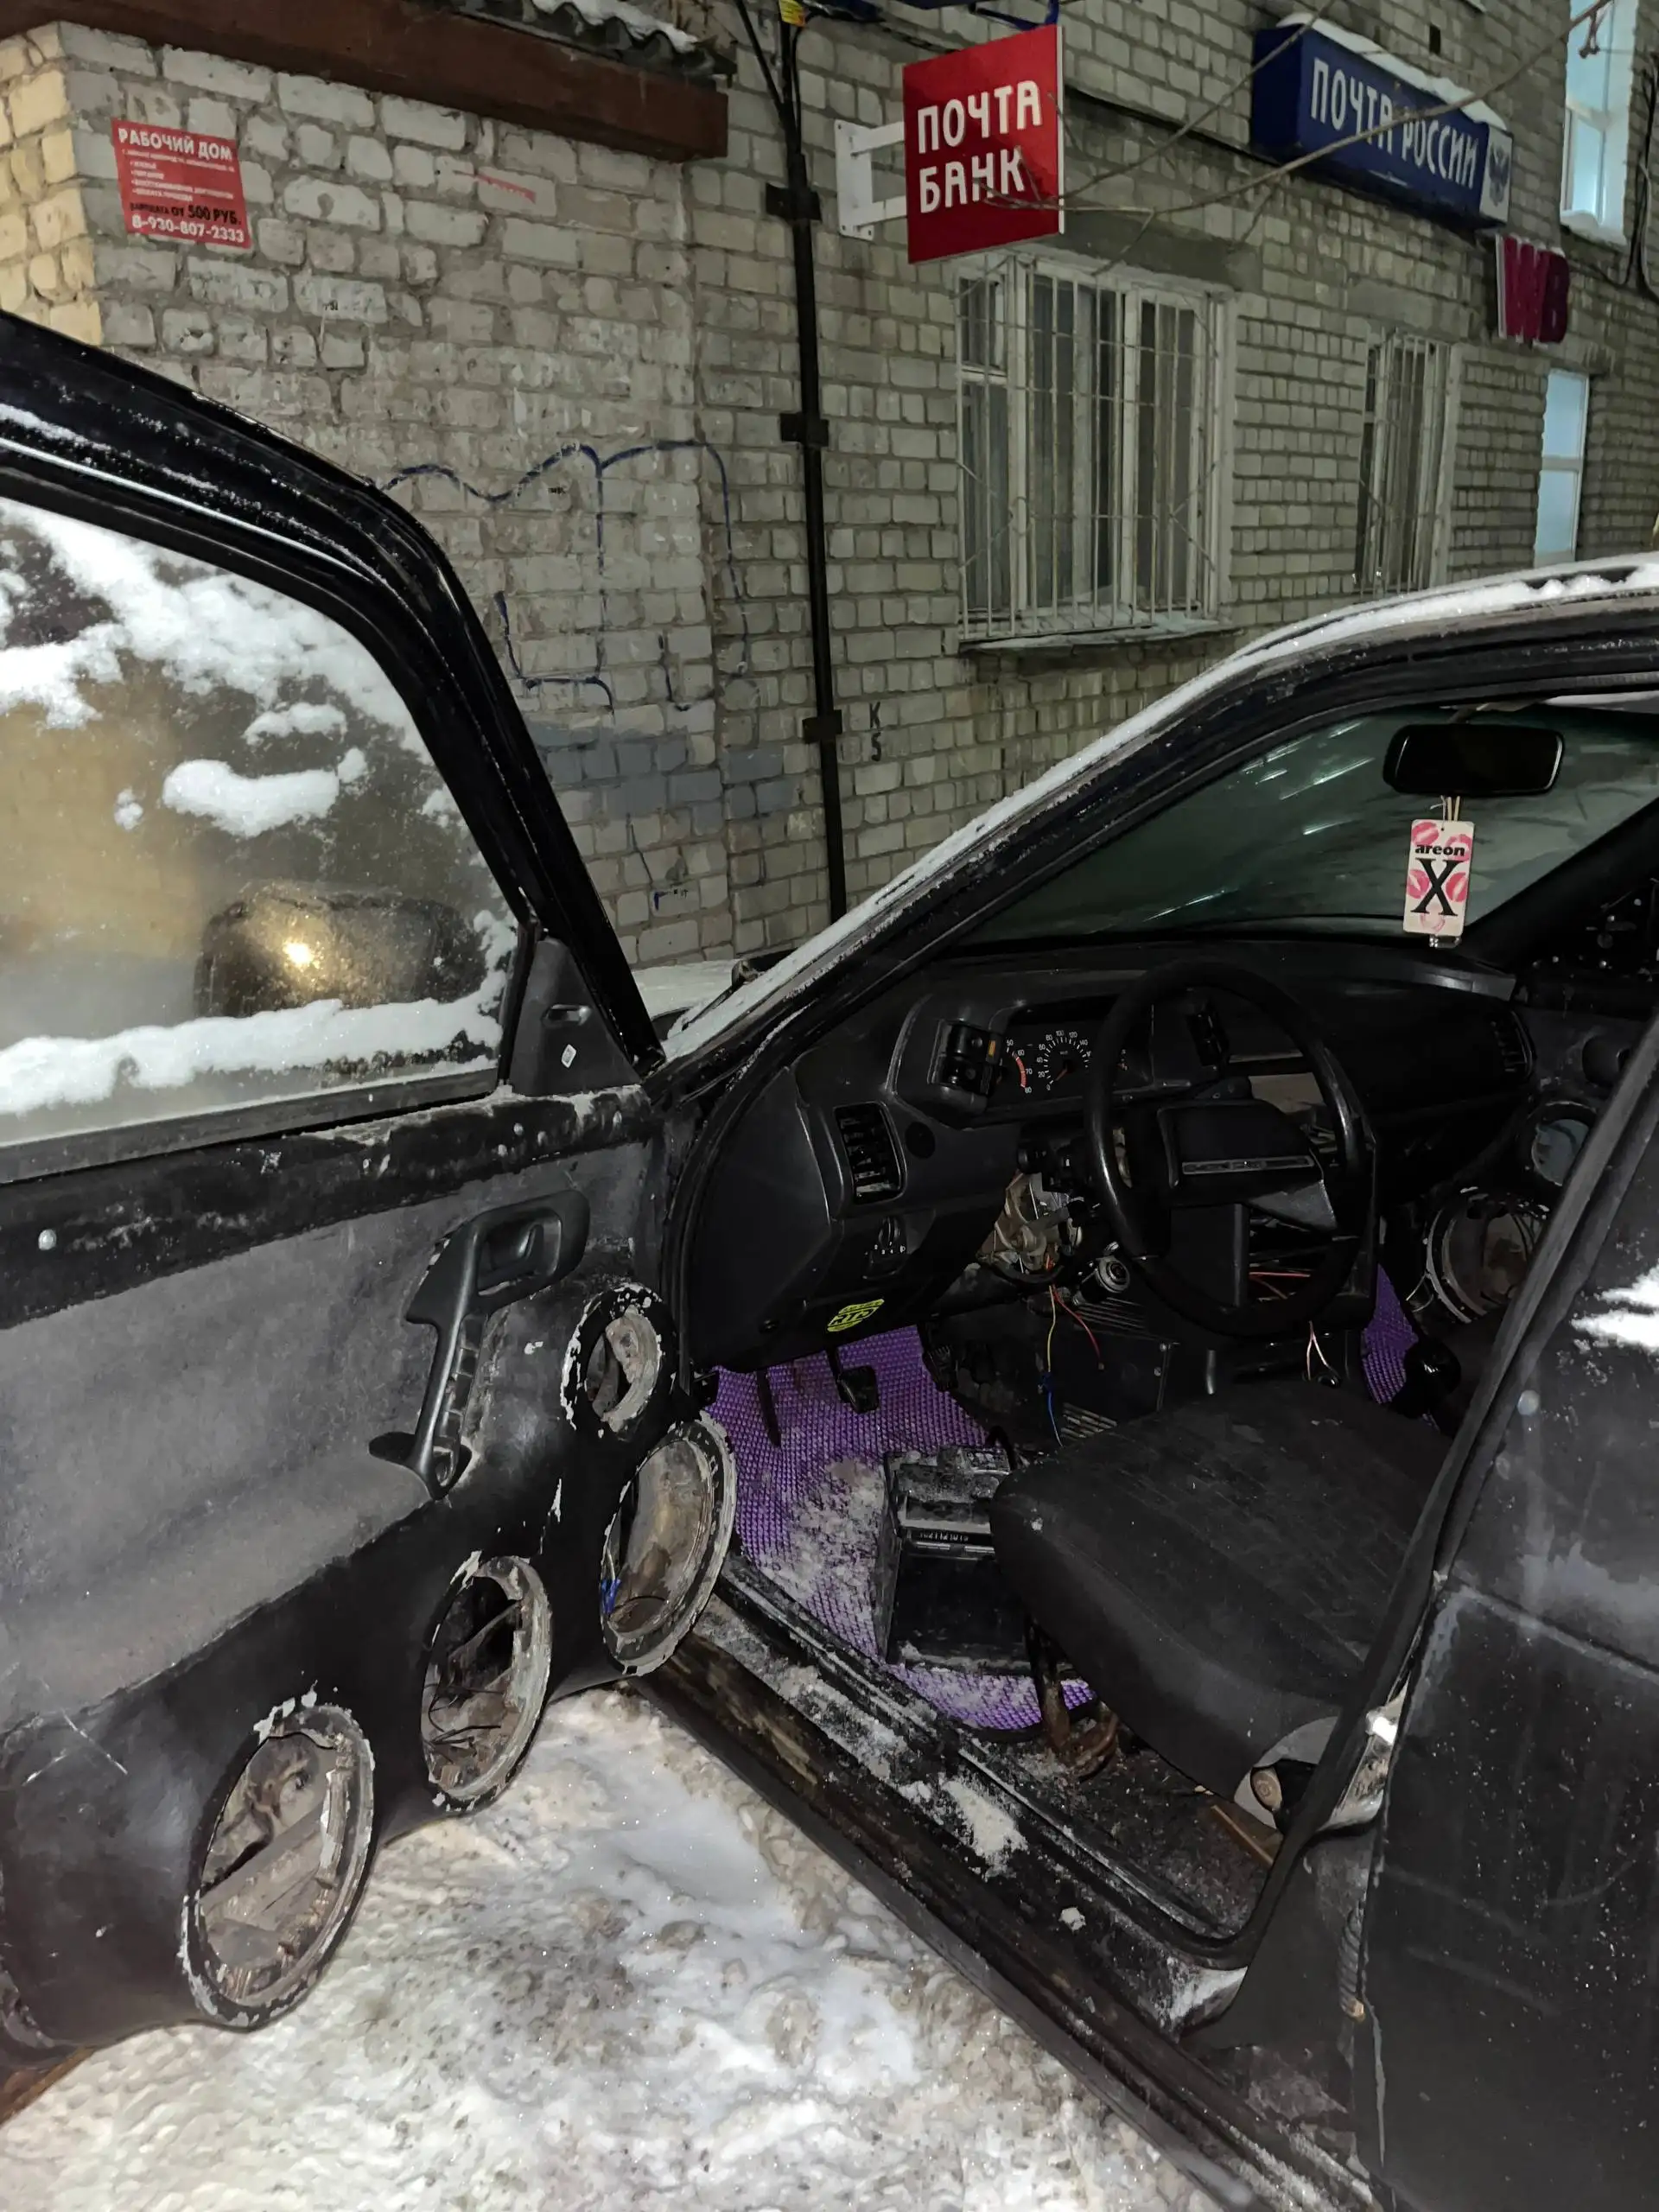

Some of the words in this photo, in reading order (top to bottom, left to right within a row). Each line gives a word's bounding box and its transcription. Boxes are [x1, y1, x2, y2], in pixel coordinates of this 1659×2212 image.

[118, 128, 194, 155] РАБОЧИЙ
[198, 141, 232, 162] ДОМ
[918, 80, 1042, 154] ПОЧТА
[1311, 57, 1393, 155] ПОЧТА
[1402, 110, 1478, 189] РОССИИ
[919, 148, 1025, 213] БАНК
[213, 208, 242, 226] РУБ.
[1415, 844, 1465, 857] areon
[1410, 857, 1465, 917] X
